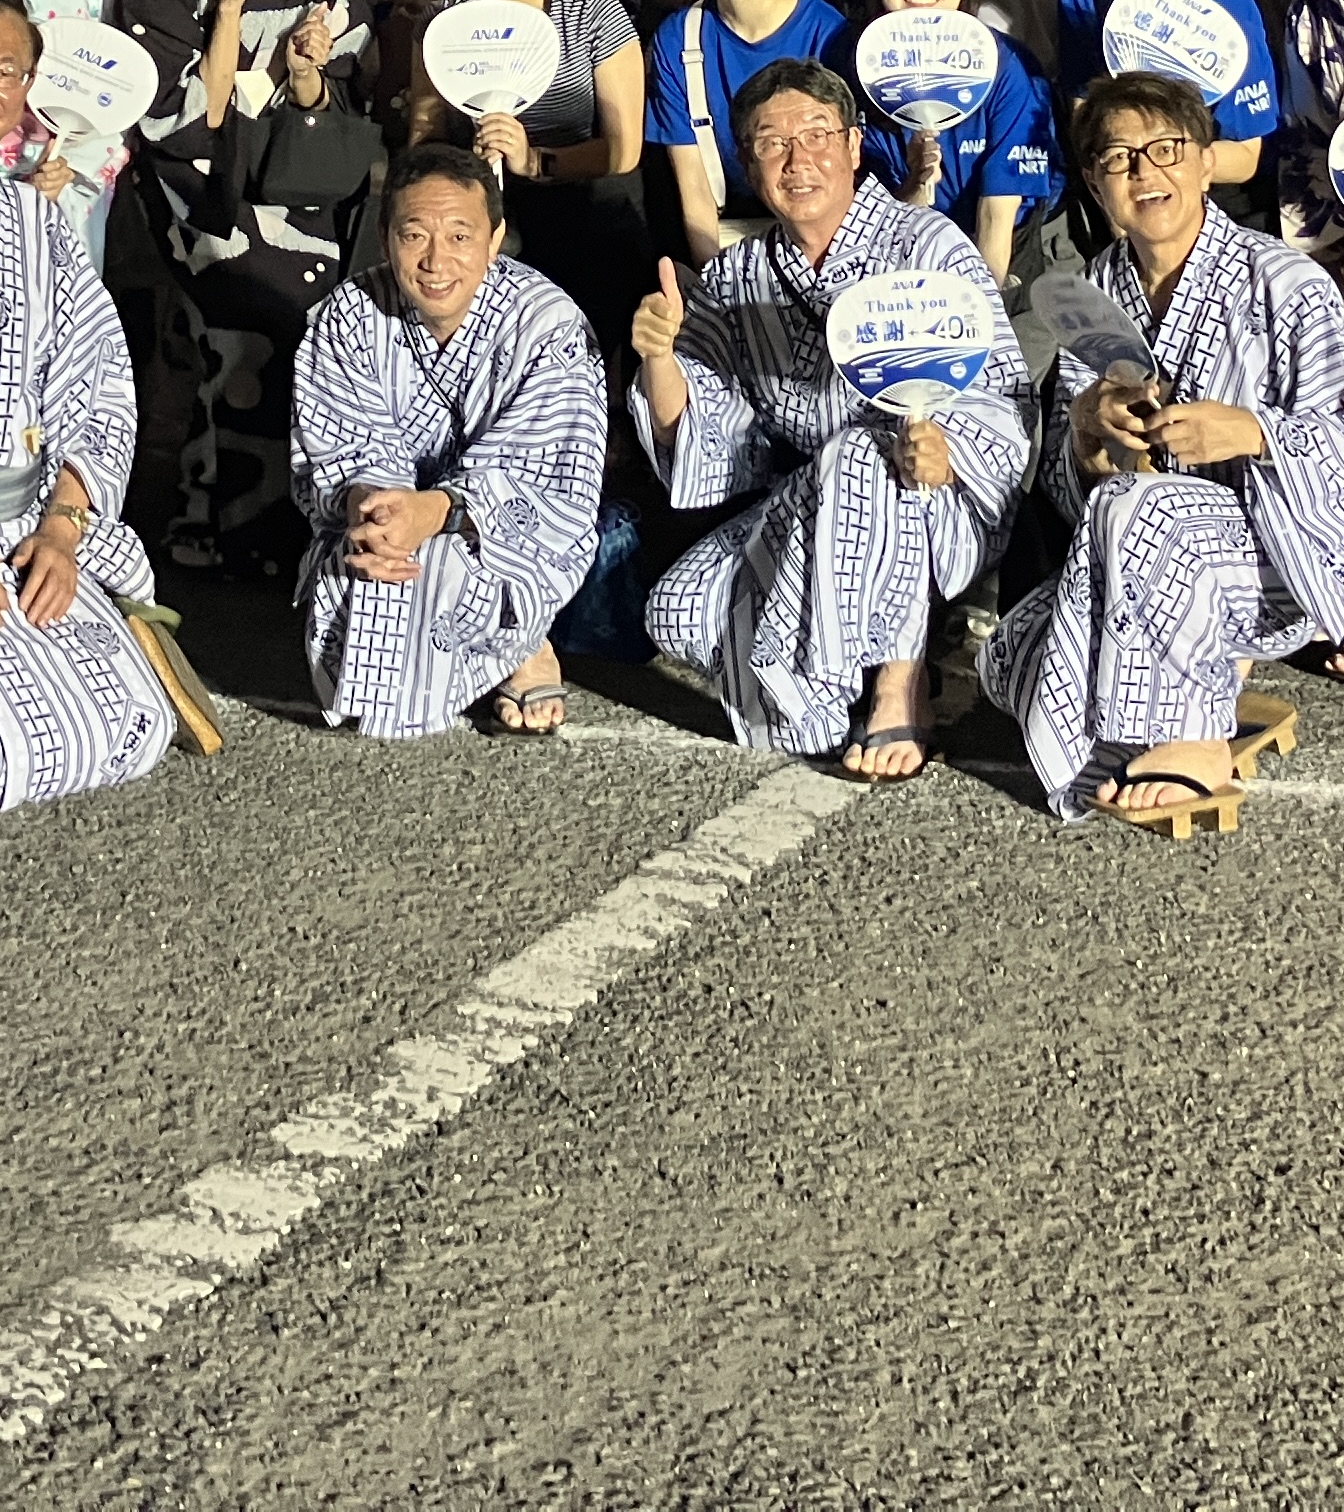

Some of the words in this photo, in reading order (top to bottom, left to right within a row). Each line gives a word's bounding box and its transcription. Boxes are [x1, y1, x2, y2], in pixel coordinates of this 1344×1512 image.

[471, 29, 500, 40] ANA
[890, 31, 931, 42] Thank
[936, 34, 959, 45] you
[1191, 24, 1217, 41] you
[72, 48, 102, 67] ANA
[1234, 80, 1269, 106] ANA
[1018, 160, 1048, 176] NRT
[864, 298, 914, 313] Thank
[920, 298, 948, 313] you
[856, 319, 905, 344] 感謝
